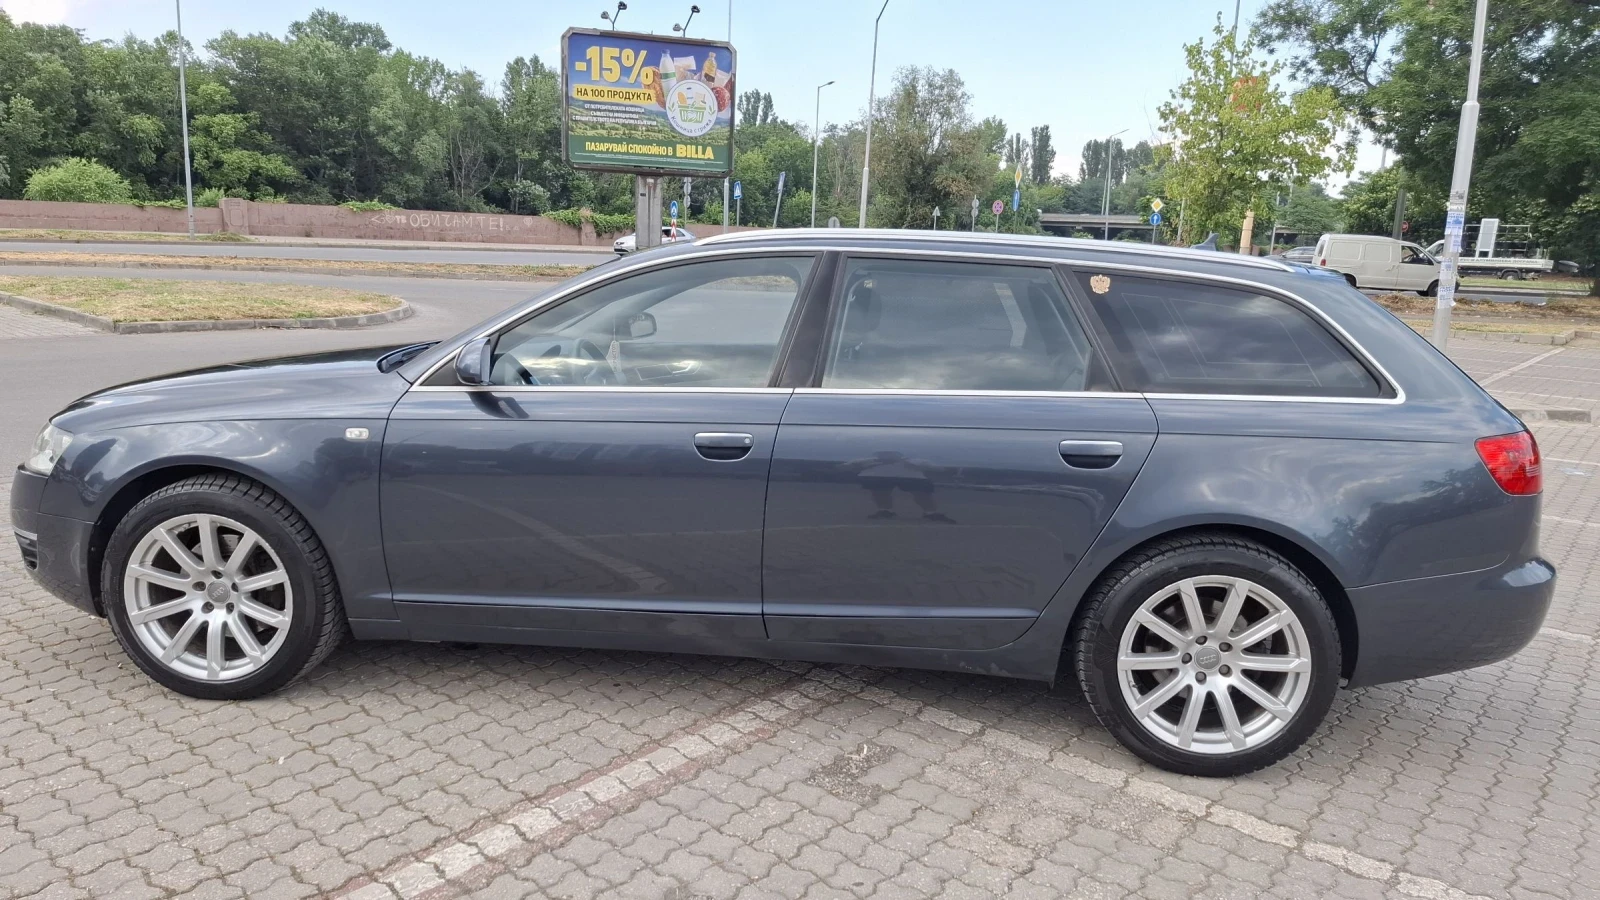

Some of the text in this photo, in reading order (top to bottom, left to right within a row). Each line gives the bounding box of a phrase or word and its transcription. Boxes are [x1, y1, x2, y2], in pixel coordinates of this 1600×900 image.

[575, 46, 654, 85] -15%
[576, 87, 652, 101] НА 100 ПРОДУКТА
[670, 115, 693, 134] Кошница
[585, 141, 628, 153] ПАЗАРУВАЙ
[628, 143, 666, 155] СПОКОЙНО
[668, 146, 673, 156] В
[676, 144, 714, 160] BILLA
